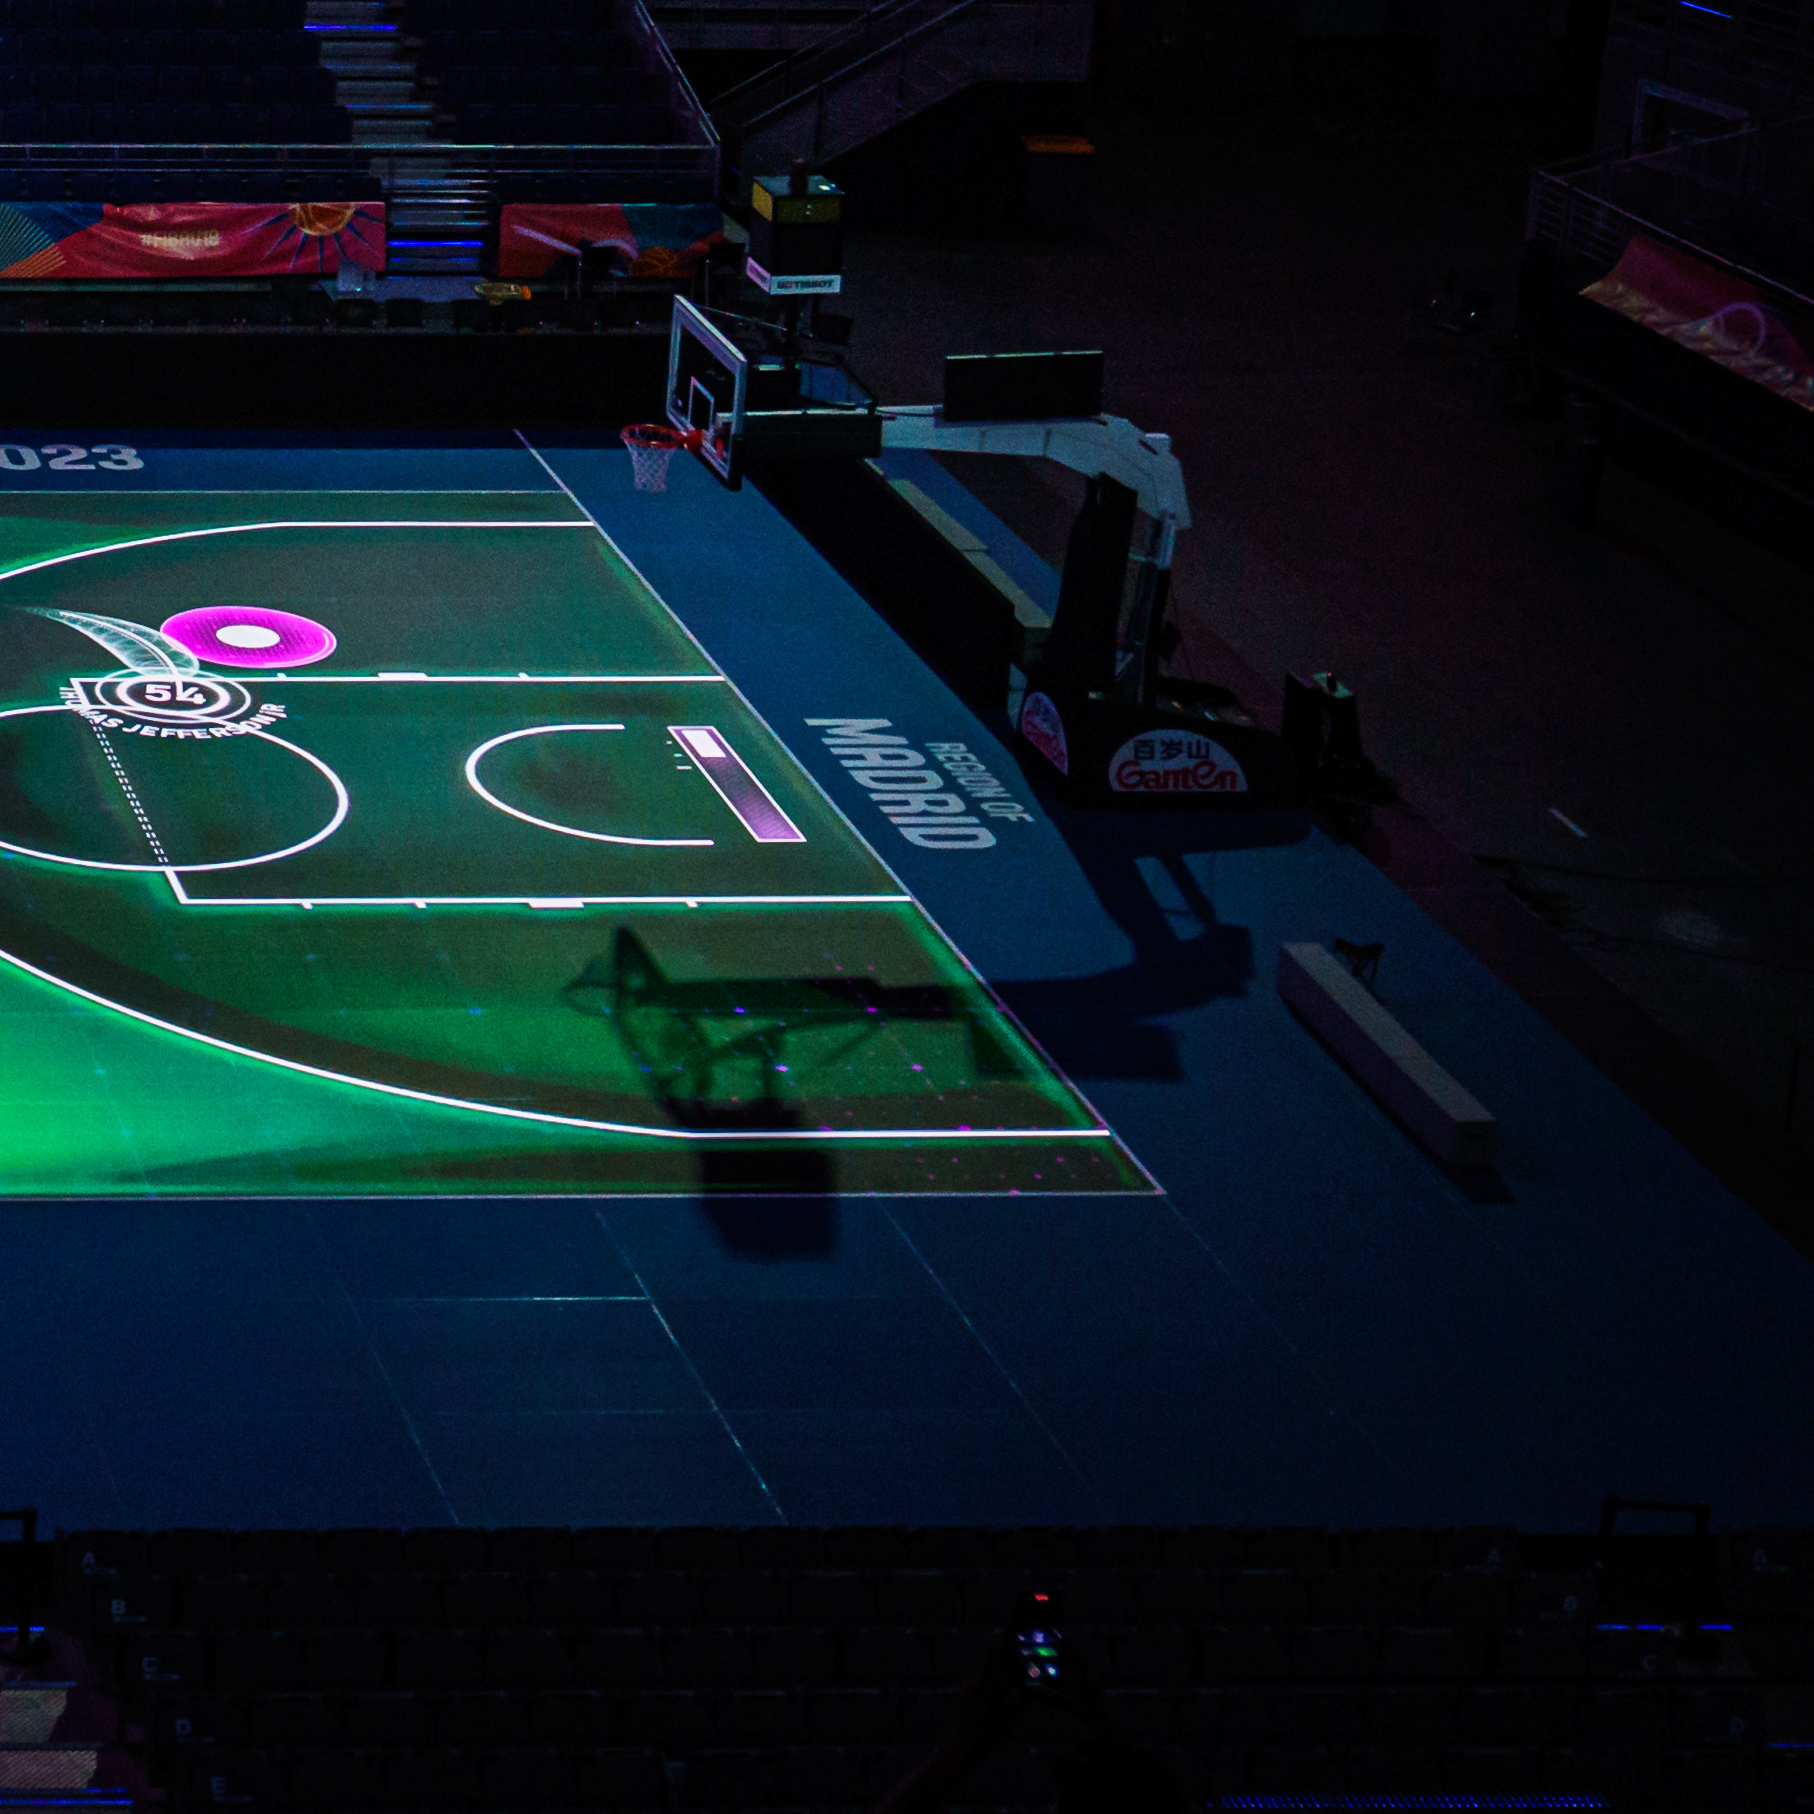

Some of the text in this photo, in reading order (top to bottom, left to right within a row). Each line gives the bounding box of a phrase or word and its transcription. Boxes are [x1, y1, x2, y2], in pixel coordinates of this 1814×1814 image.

[145, 683, 207, 705] 54
[1134, 738, 1210, 761] 百岁山
[803, 718, 997, 850] MADRID
[925, 742, 1035, 823] REGION OF
